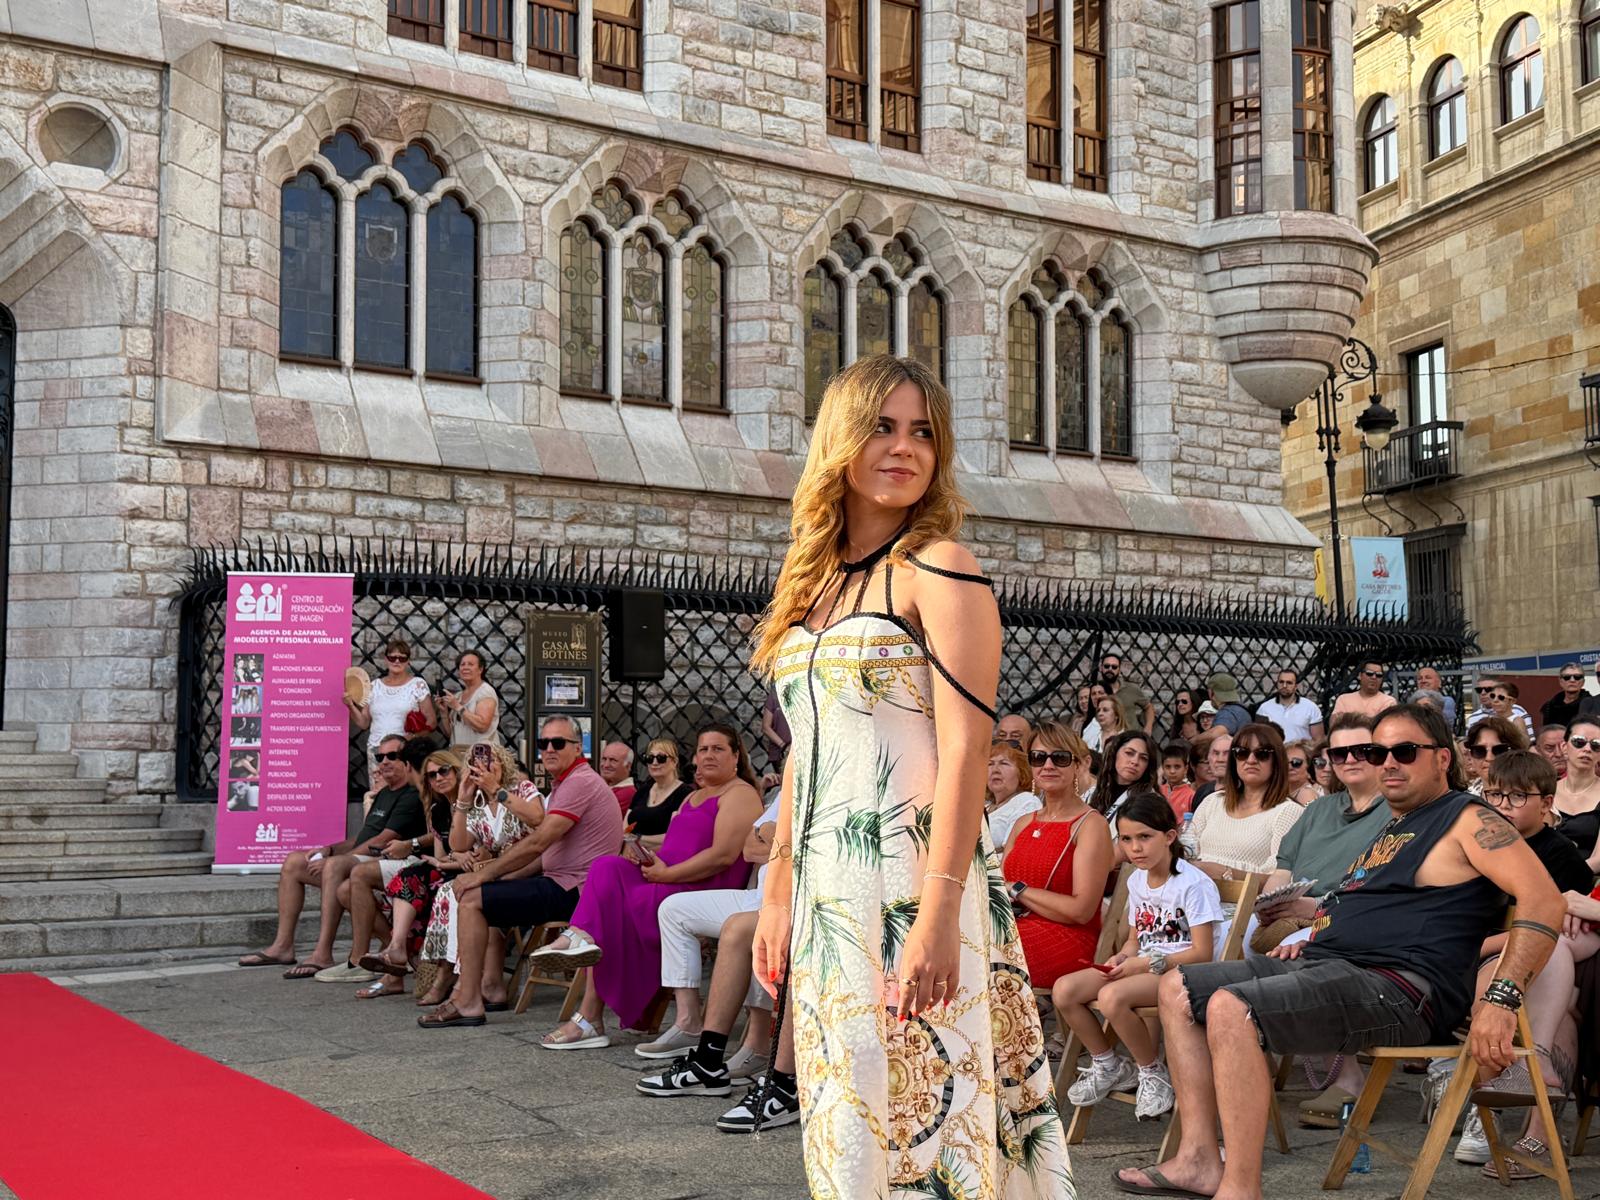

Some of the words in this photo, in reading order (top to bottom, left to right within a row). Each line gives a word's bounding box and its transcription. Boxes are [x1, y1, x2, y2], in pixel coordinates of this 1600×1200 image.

[291, 595, 315, 603] CENTRO
[291, 603, 345, 613] PERSONALIZACIÓN
[290, 614, 299, 622] DE
[300, 614, 324, 622] IMAGEN
[250, 629, 281, 637] AGENCIA
[282, 629, 292, 637] DE
[233, 636, 269, 644] MODELOS
[275, 636, 312, 645] PERSONAL
[313, 637, 344, 645] AUXILIAR
[542, 641, 569, 650] CASA
[542, 650, 587, 660] BOTINES
